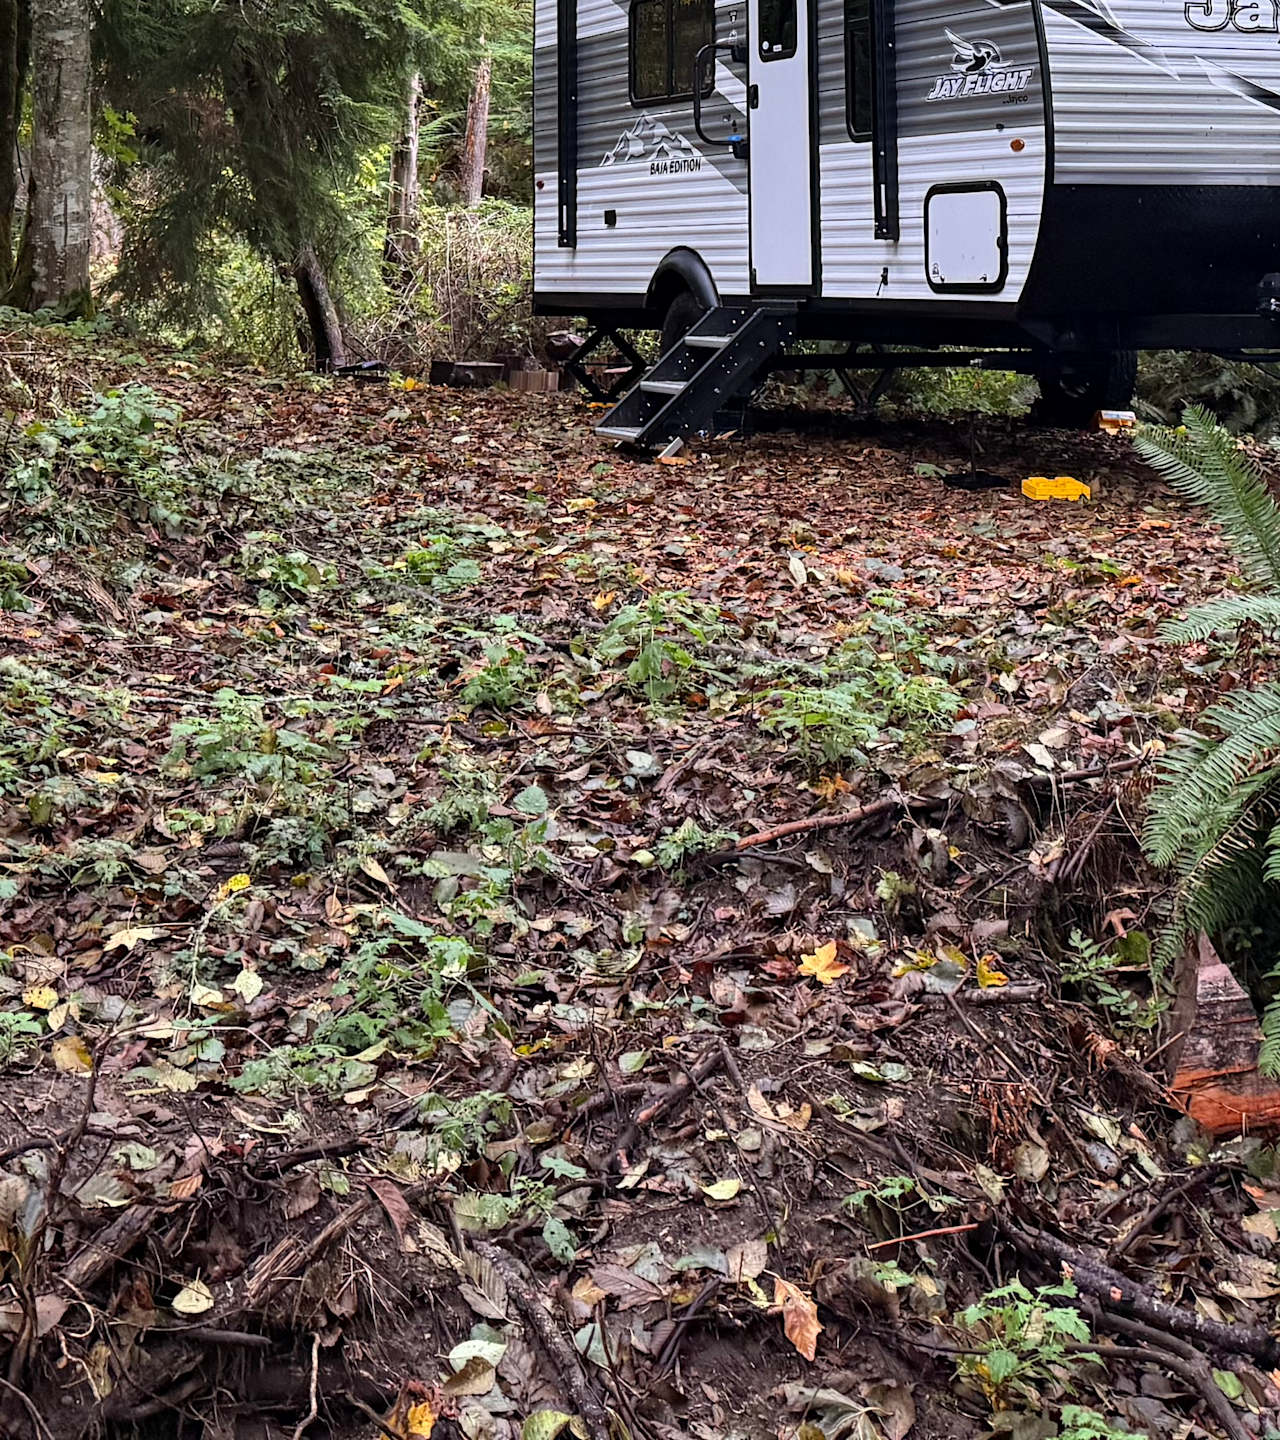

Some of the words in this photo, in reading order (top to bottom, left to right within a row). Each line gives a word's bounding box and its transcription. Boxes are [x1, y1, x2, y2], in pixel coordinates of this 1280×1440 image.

[927, 78, 962, 100] JAY
[961, 70, 1033, 96] FLIGHT
[650, 162, 668, 175] BAJA
[669, 159, 701, 173] EDITION
